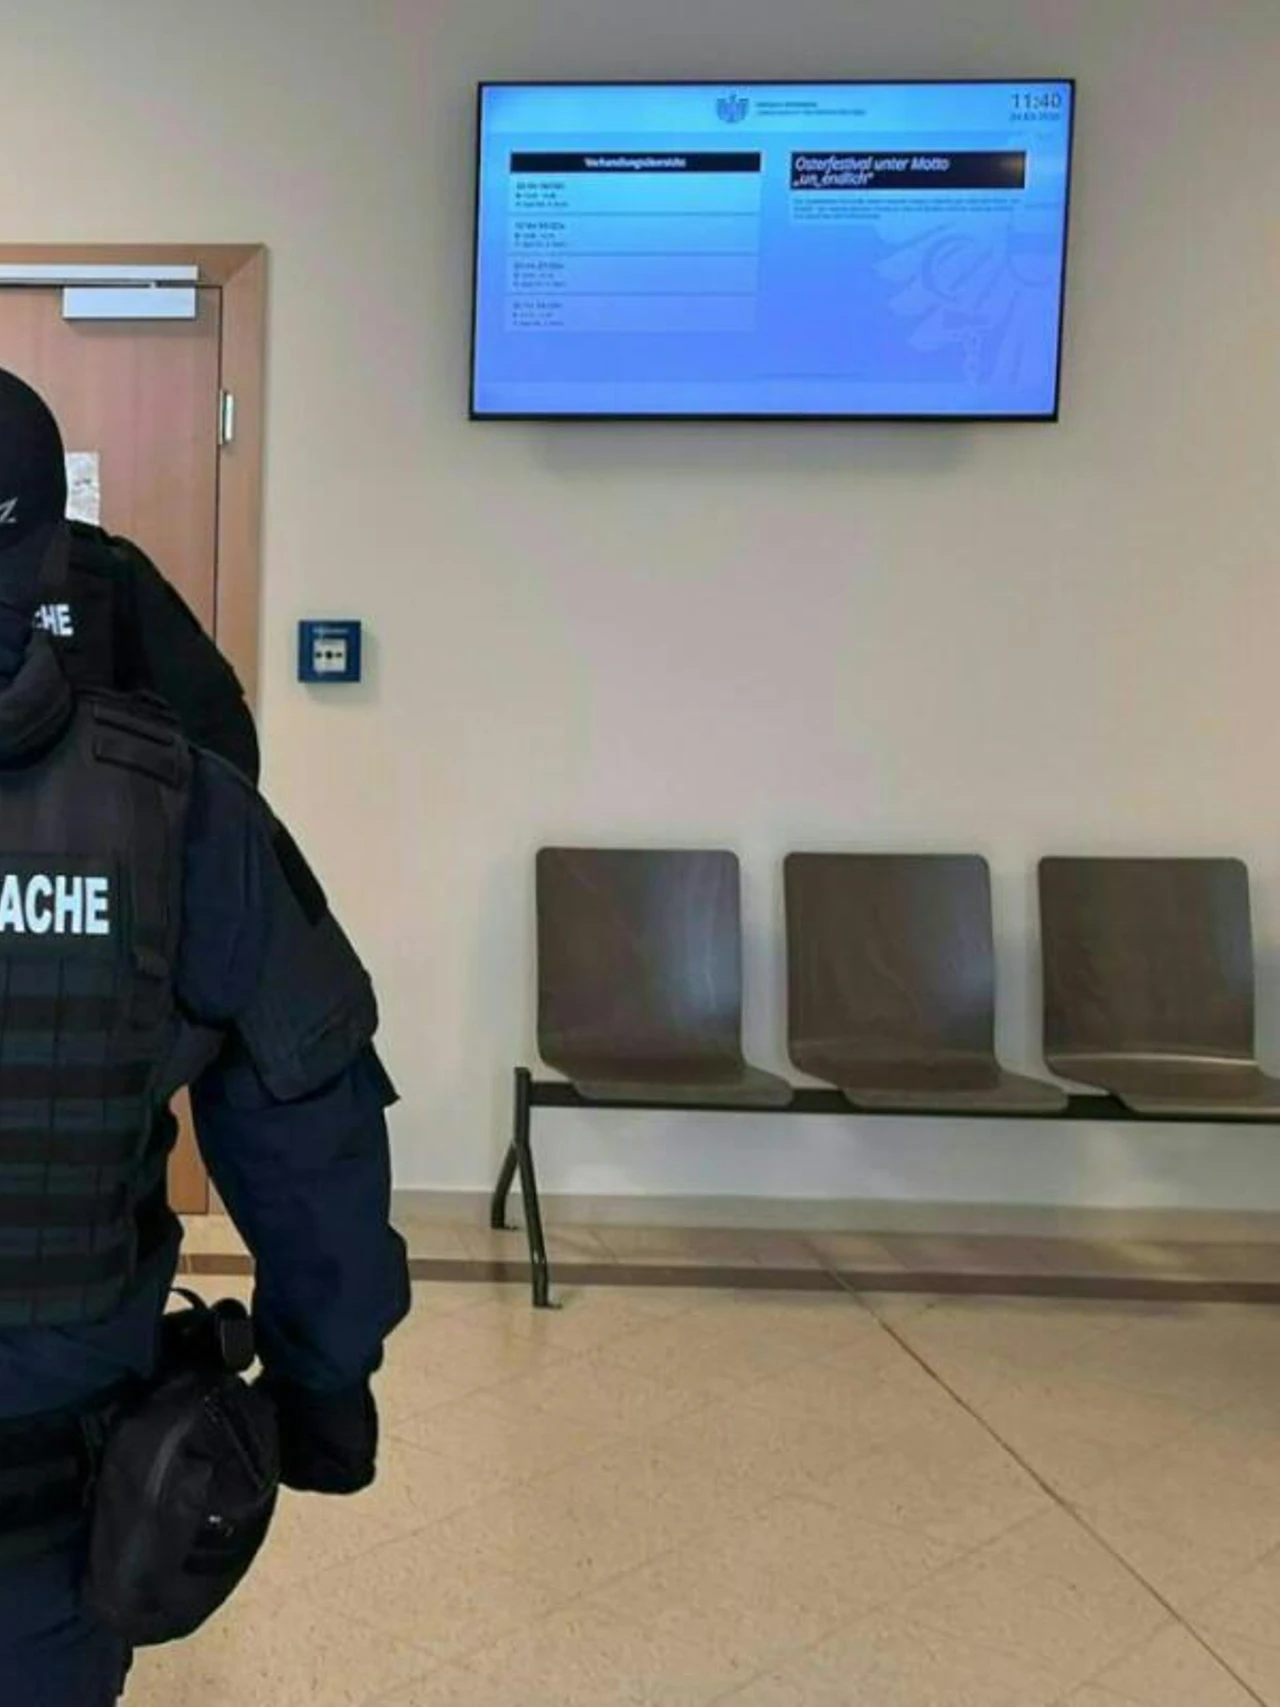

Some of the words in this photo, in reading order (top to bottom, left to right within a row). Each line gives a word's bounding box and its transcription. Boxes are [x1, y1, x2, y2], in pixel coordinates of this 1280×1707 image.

[1010, 92, 1062, 109] 11:40
[795, 155, 873, 174] Osterfestival
[874, 157, 908, 171] unter
[910, 156, 951, 171] Motto
